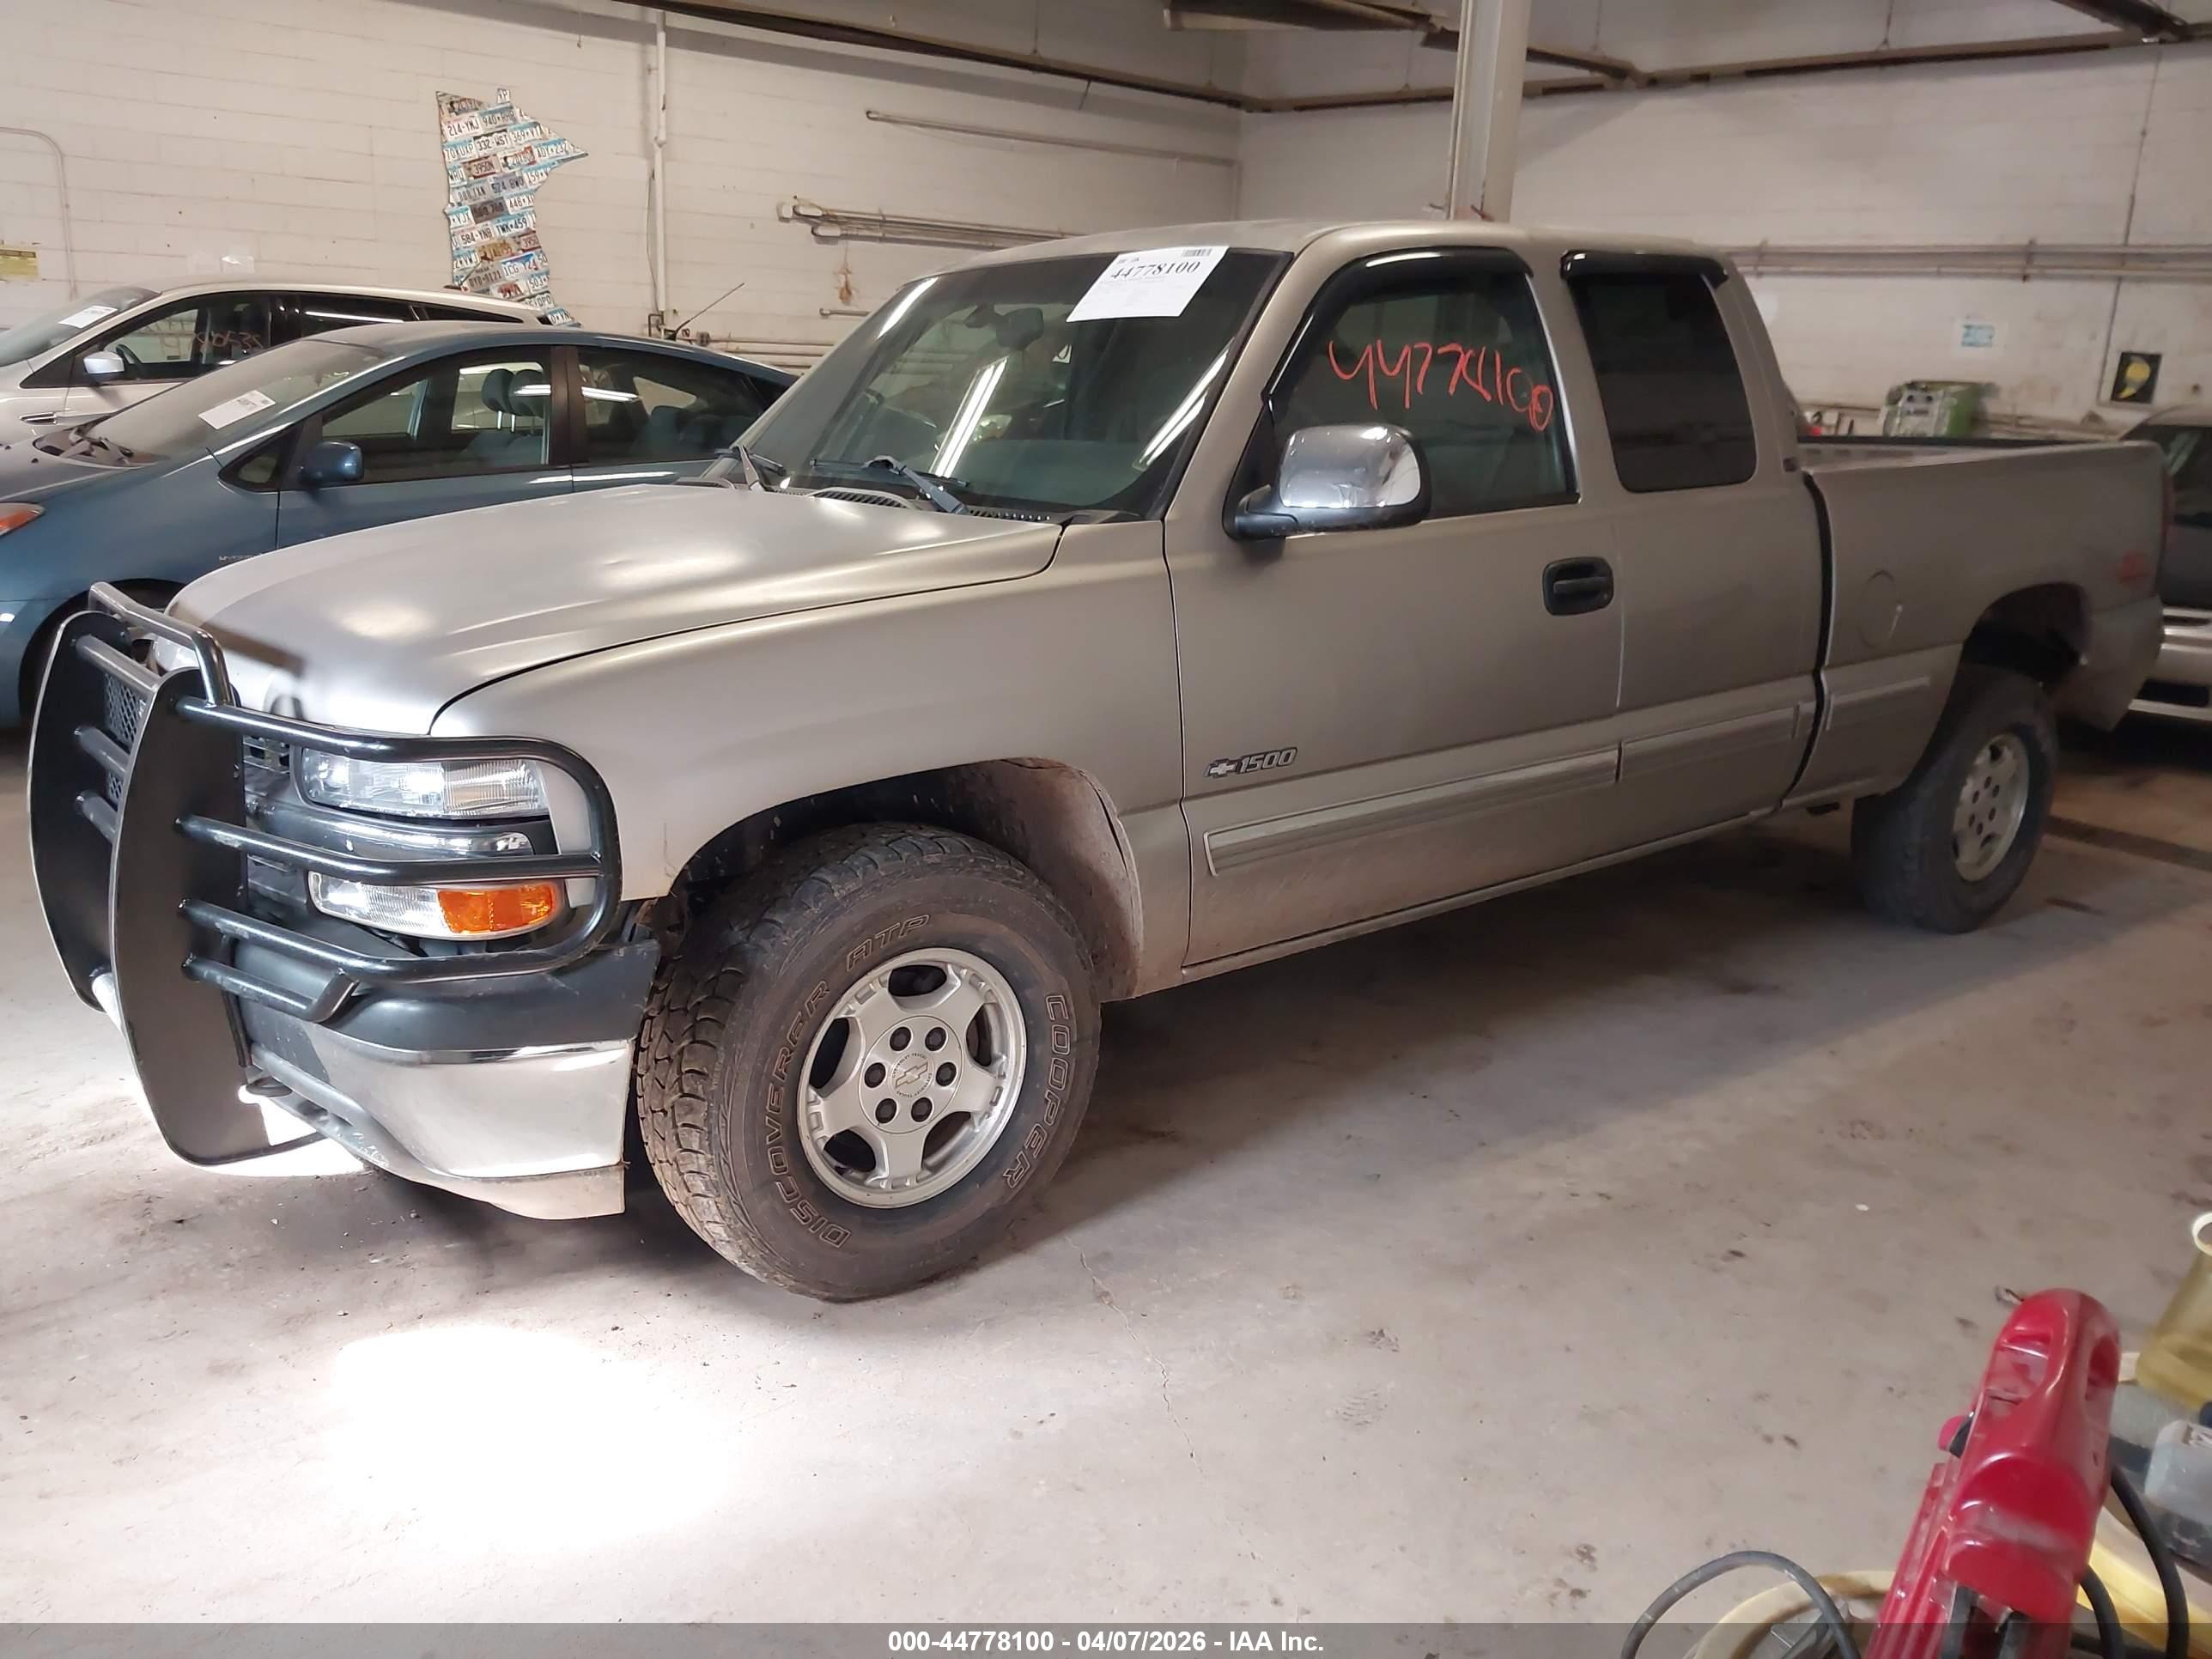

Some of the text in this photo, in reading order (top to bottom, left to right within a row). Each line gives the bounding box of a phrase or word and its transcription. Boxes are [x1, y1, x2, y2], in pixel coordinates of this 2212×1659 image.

[1111, 261, 1200, 280] 44778100
[1240, 748, 1297, 773] 1500
[765, 914, 930, 1248] DISCOVERER ATP
[1003, 994, 1070, 1188] COOPER
